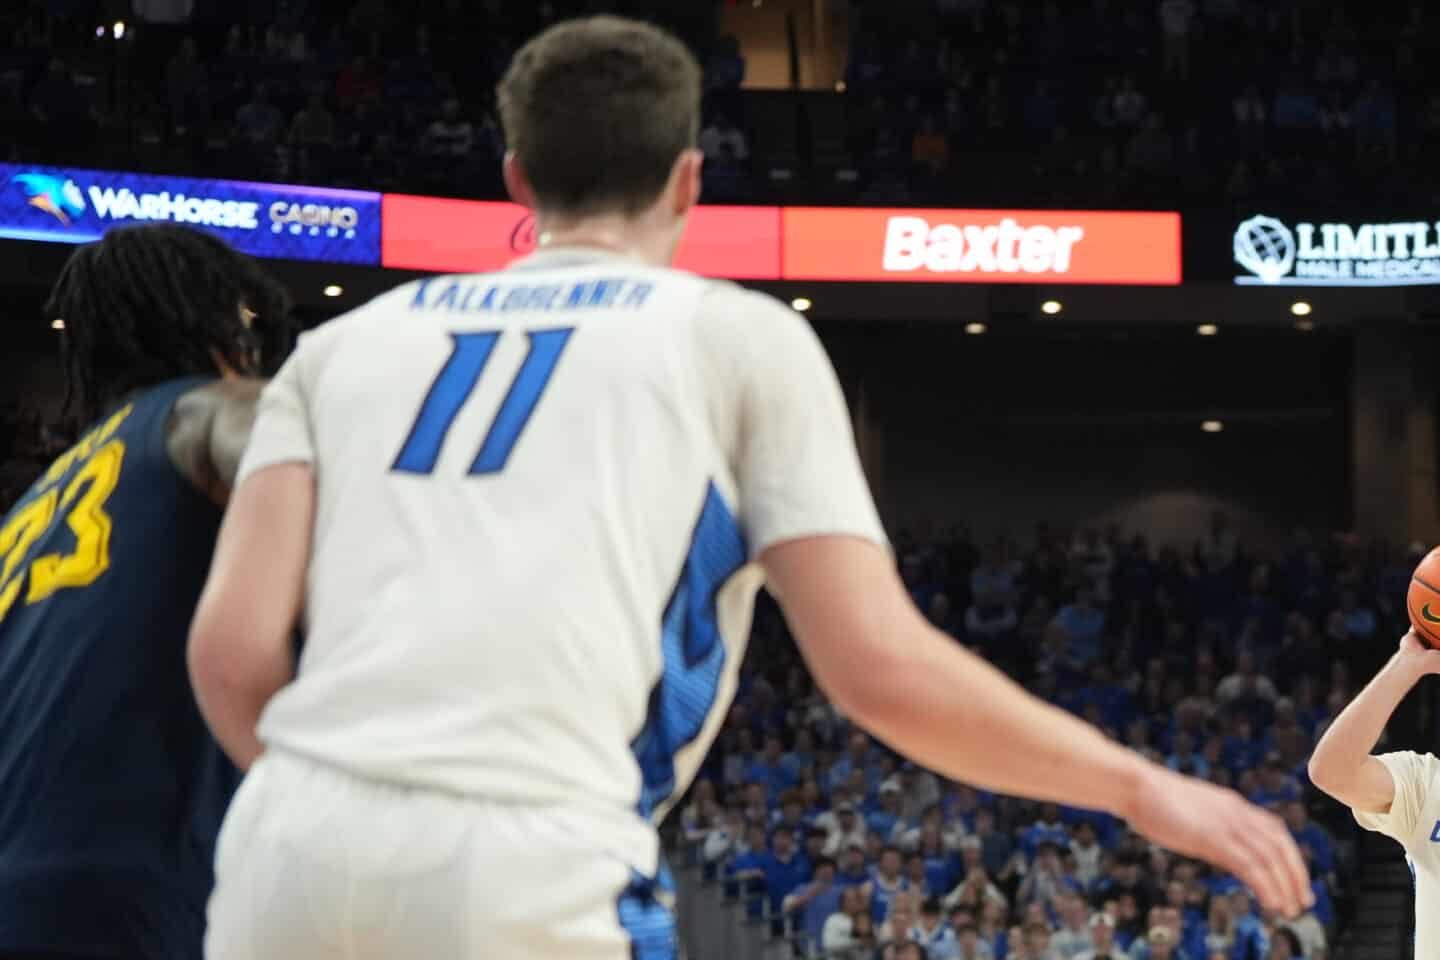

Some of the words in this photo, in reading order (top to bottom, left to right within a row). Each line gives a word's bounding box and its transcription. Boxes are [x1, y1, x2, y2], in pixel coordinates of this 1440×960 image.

[268, 201, 358, 229] CASINO
[882, 216, 1083, 274] Baxter
[390, 327, 576, 476] 11
